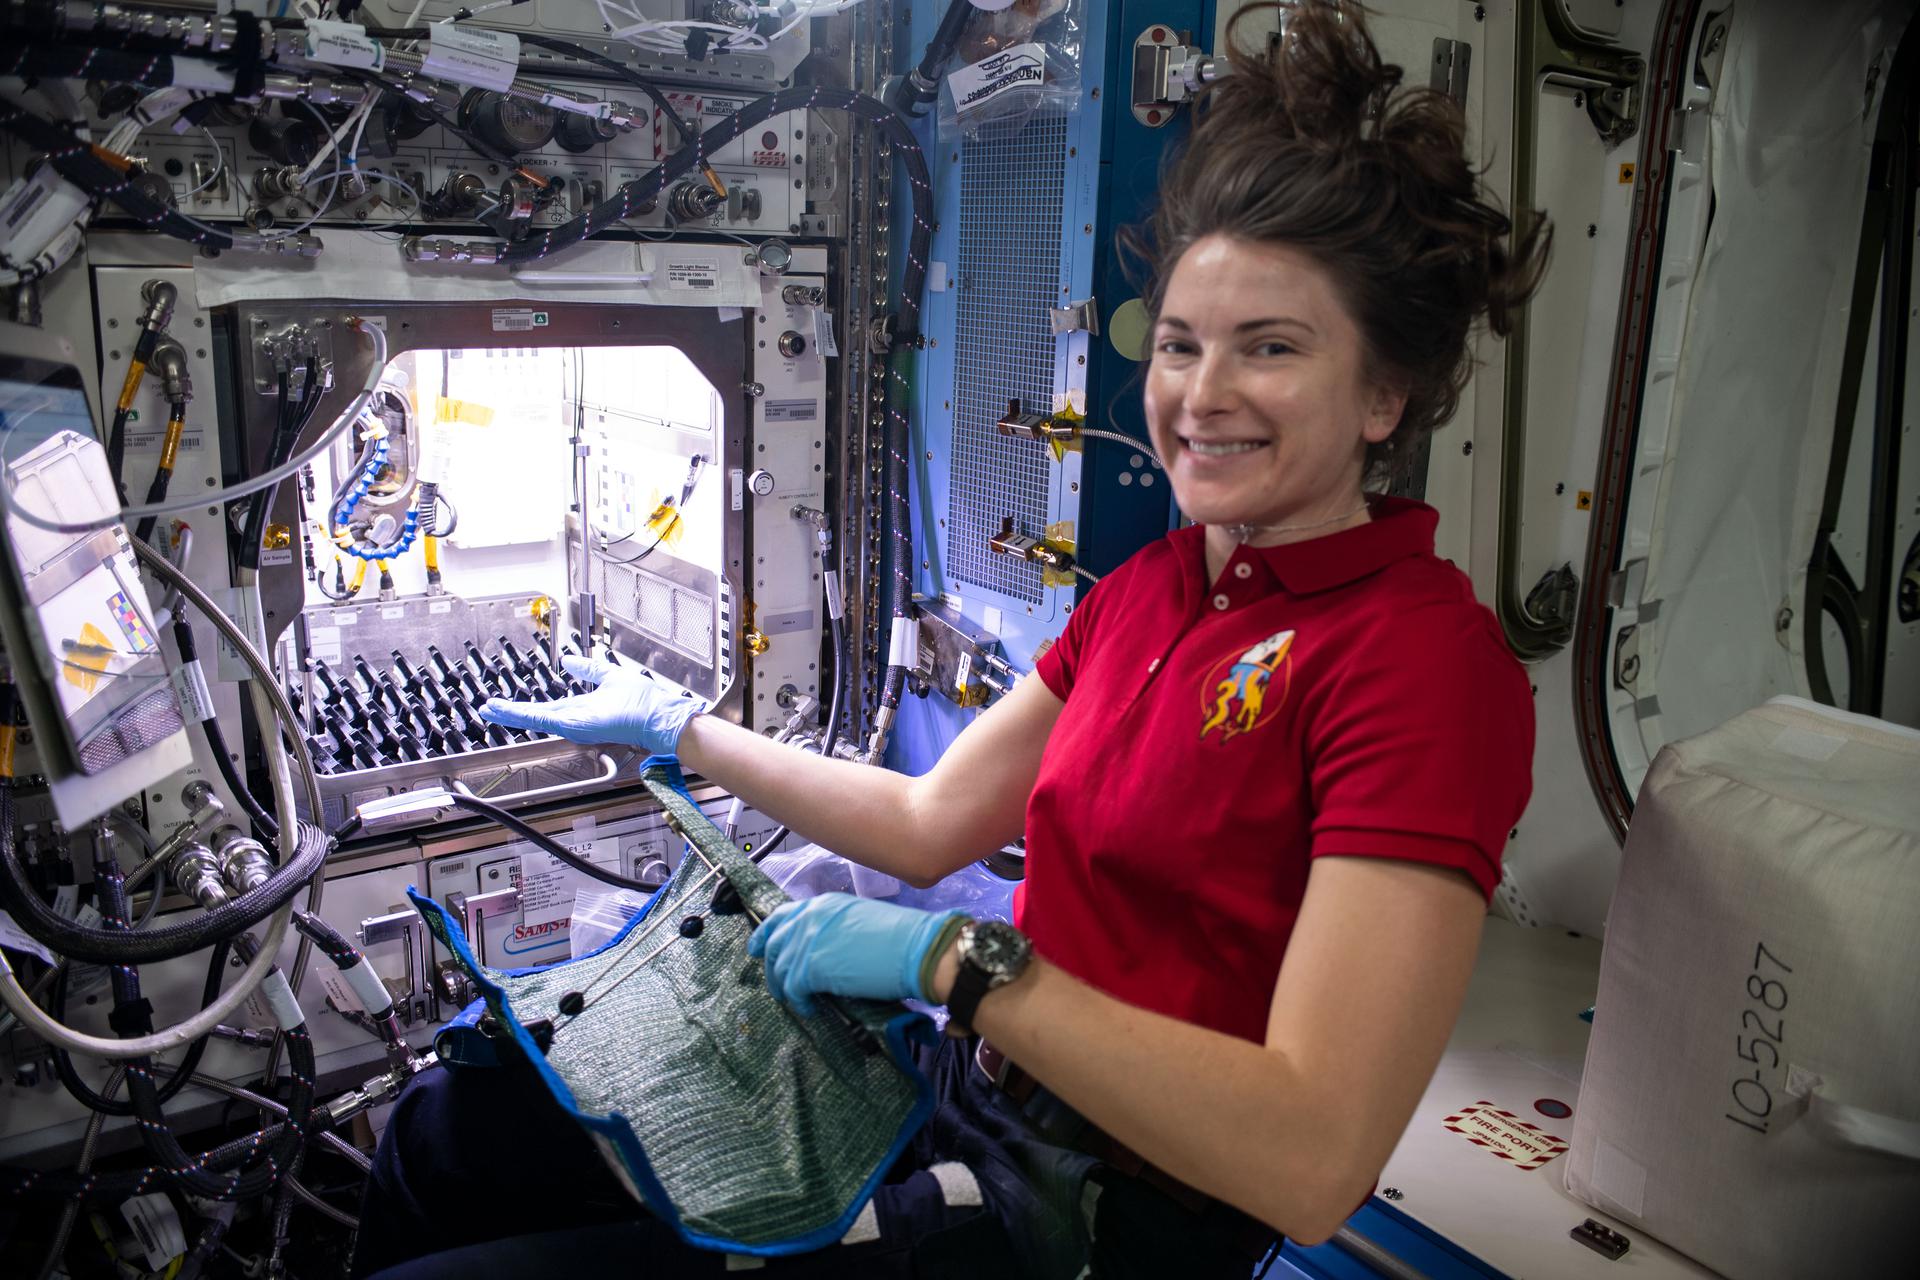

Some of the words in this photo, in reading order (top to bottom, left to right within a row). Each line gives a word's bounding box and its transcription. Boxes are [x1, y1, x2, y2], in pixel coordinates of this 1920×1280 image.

[711, 100, 733, 108] SMOKE
[1469, 1115, 1502, 1134] FIRE
[1501, 1132, 1542, 1154] PORT
[1481, 1108, 1534, 1138] EMERGENCY
[1534, 1136, 1553, 1148] USE
